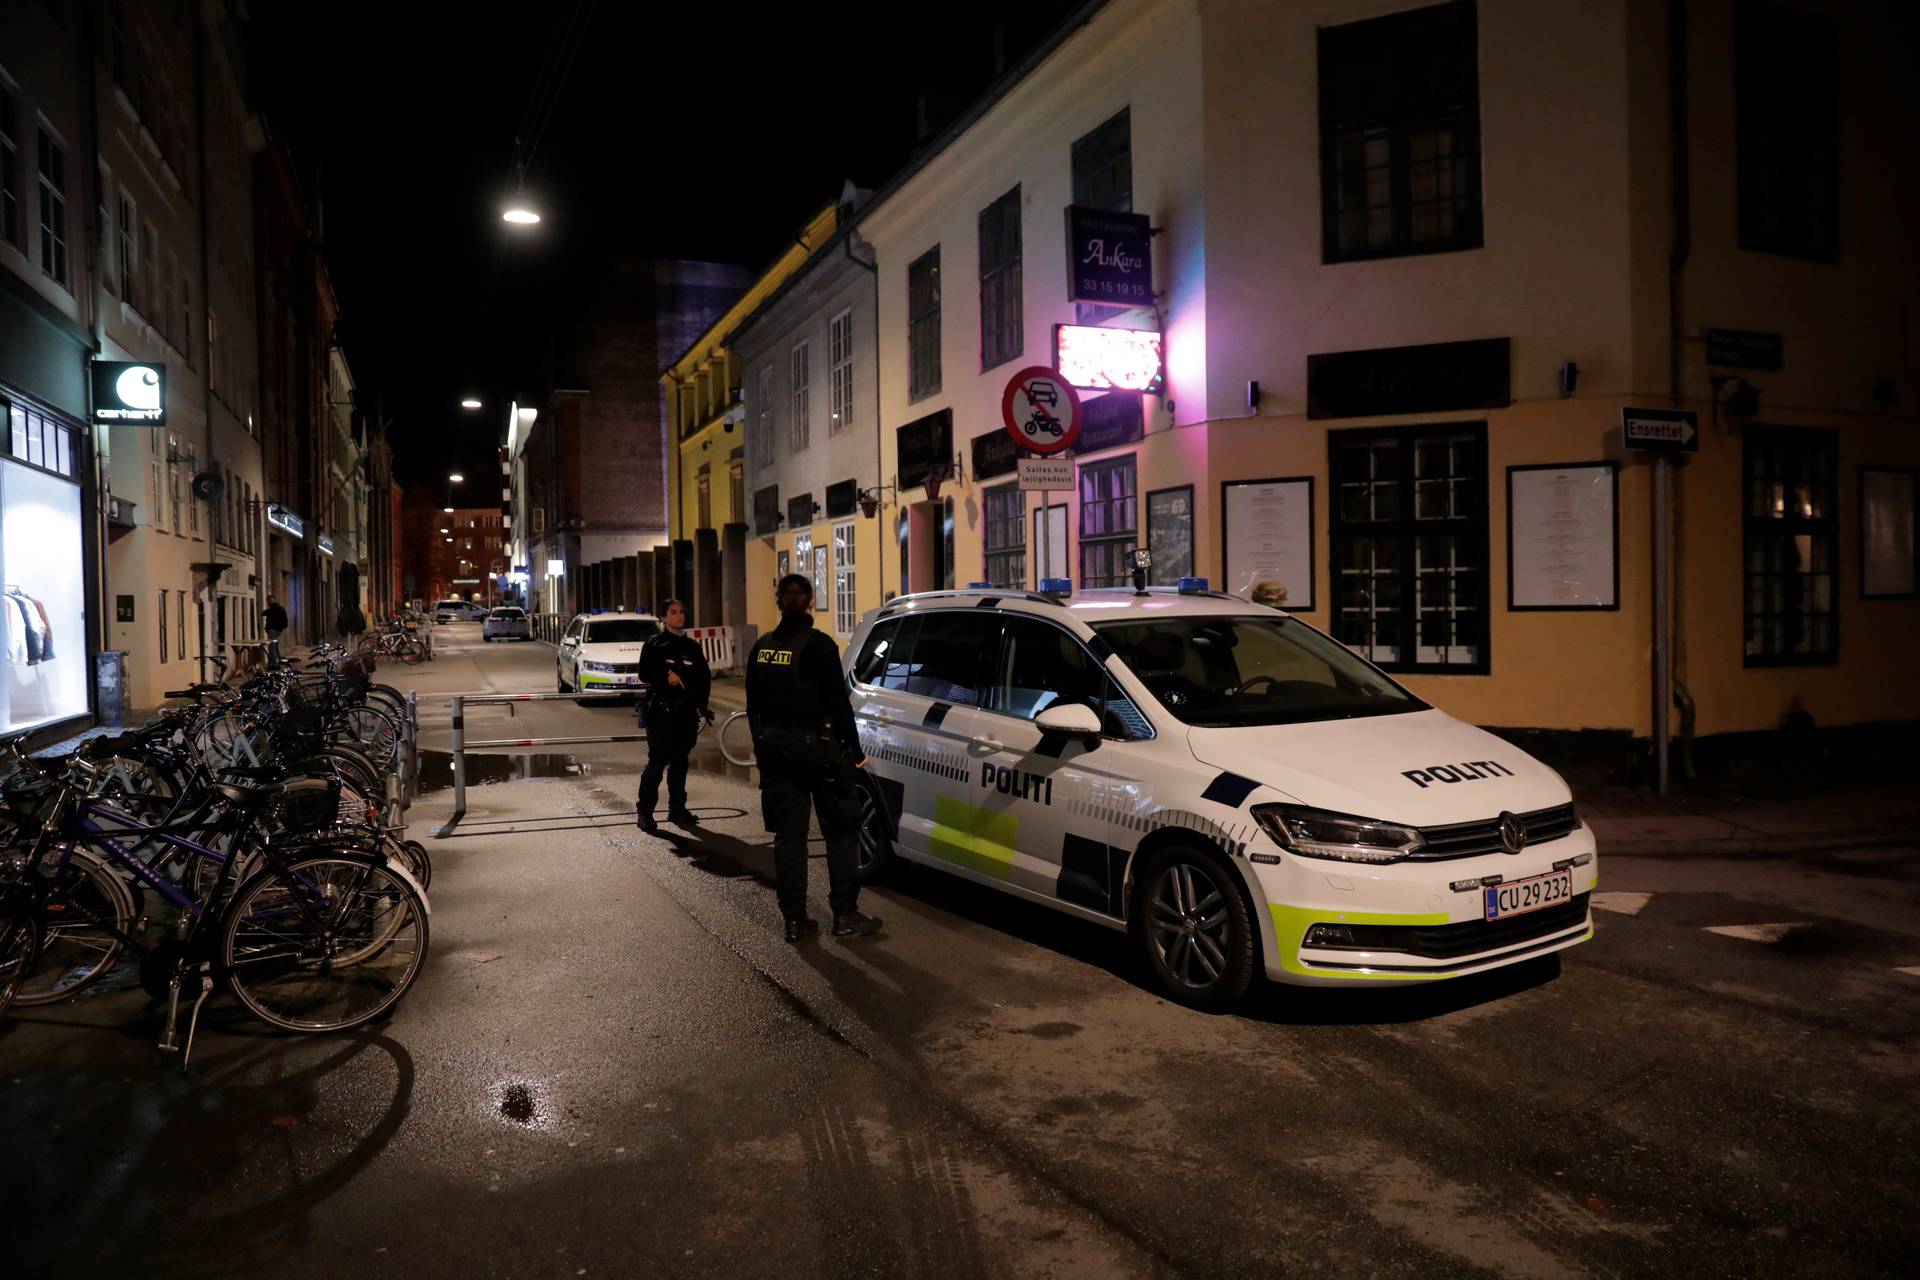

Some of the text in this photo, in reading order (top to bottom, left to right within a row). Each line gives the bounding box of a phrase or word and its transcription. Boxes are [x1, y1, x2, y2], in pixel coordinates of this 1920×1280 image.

[1083, 239, 1142, 273] Ankara
[1083, 279, 1145, 297] 33 15 19 15
[1629, 421, 1683, 439] Ensrettet
[758, 650, 791, 664] POLITI
[981, 761, 1053, 806] POLITI
[1400, 760, 1515, 788] POLITI
[1499, 876, 1569, 911] CU 29 232
